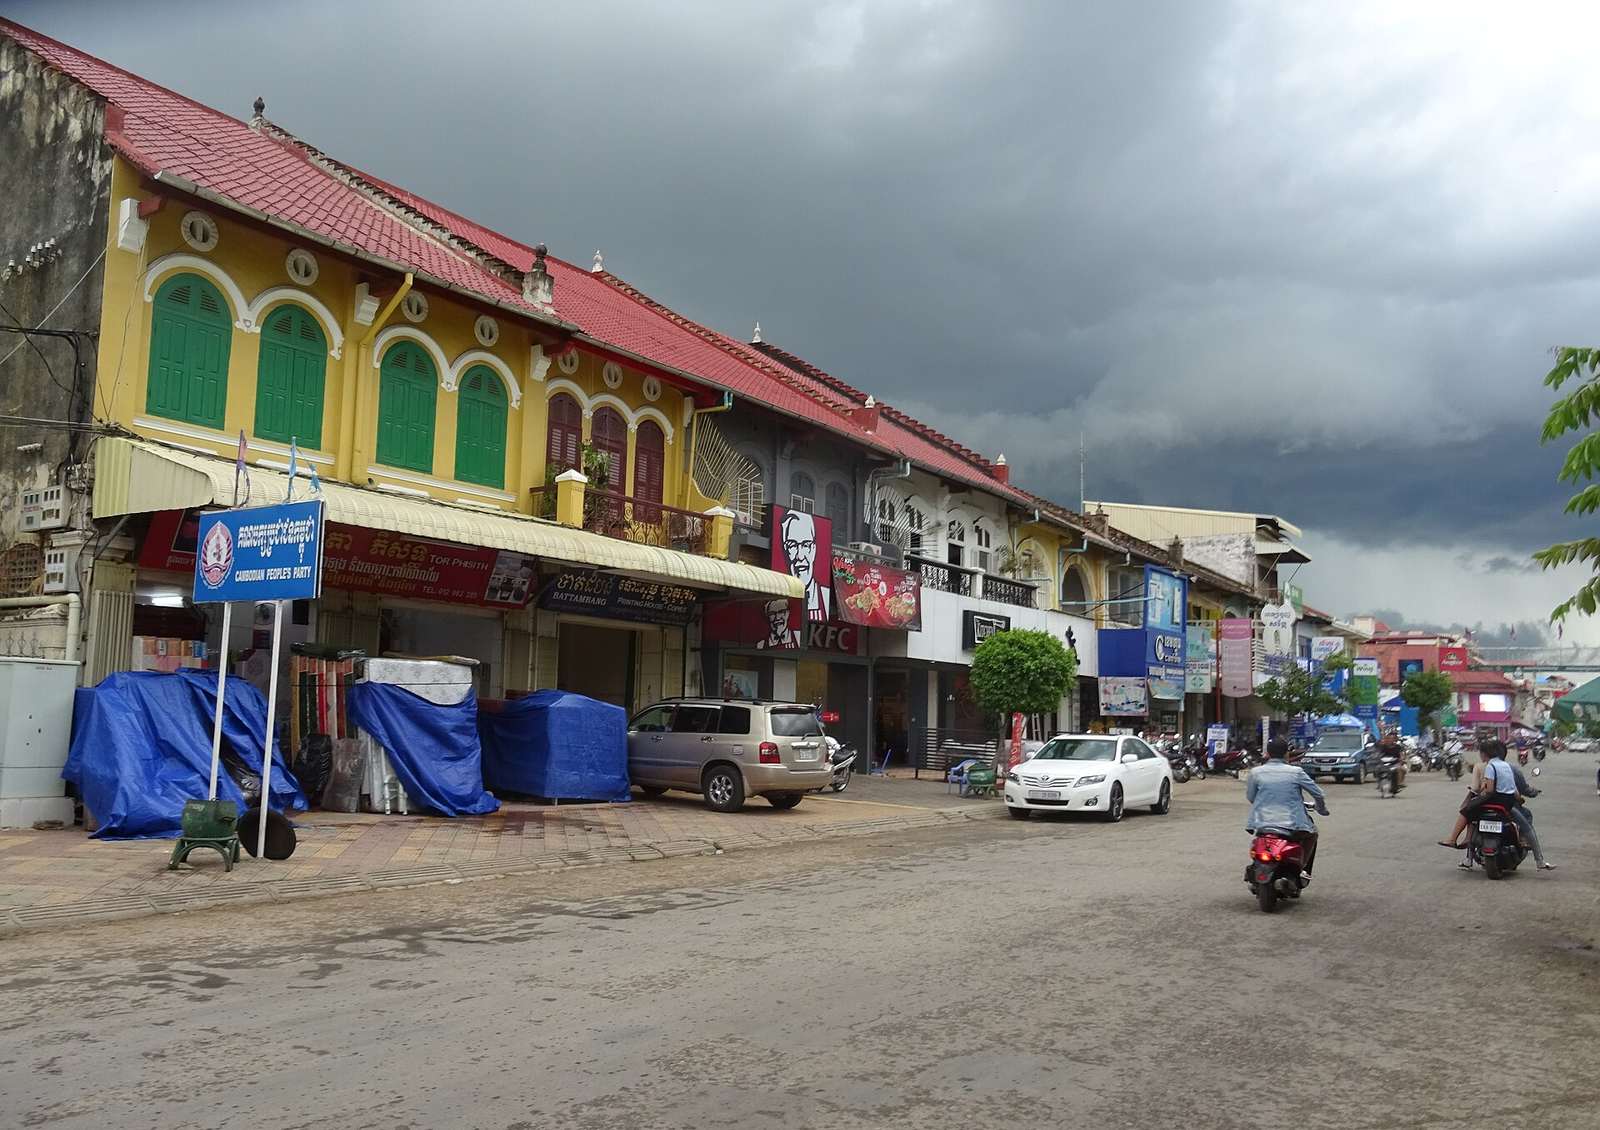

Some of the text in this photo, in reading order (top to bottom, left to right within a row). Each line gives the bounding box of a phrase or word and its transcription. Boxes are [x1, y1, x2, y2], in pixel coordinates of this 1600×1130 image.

[430, 554, 489, 570] TOR PHISITH
[235, 566, 312, 582] CAMBODIAN PEOPLE'S PARTY
[552, 591, 606, 606] BATTAMBANG
[617, 597, 644, 608] PRINTING
[808, 624, 851, 650] KFC
